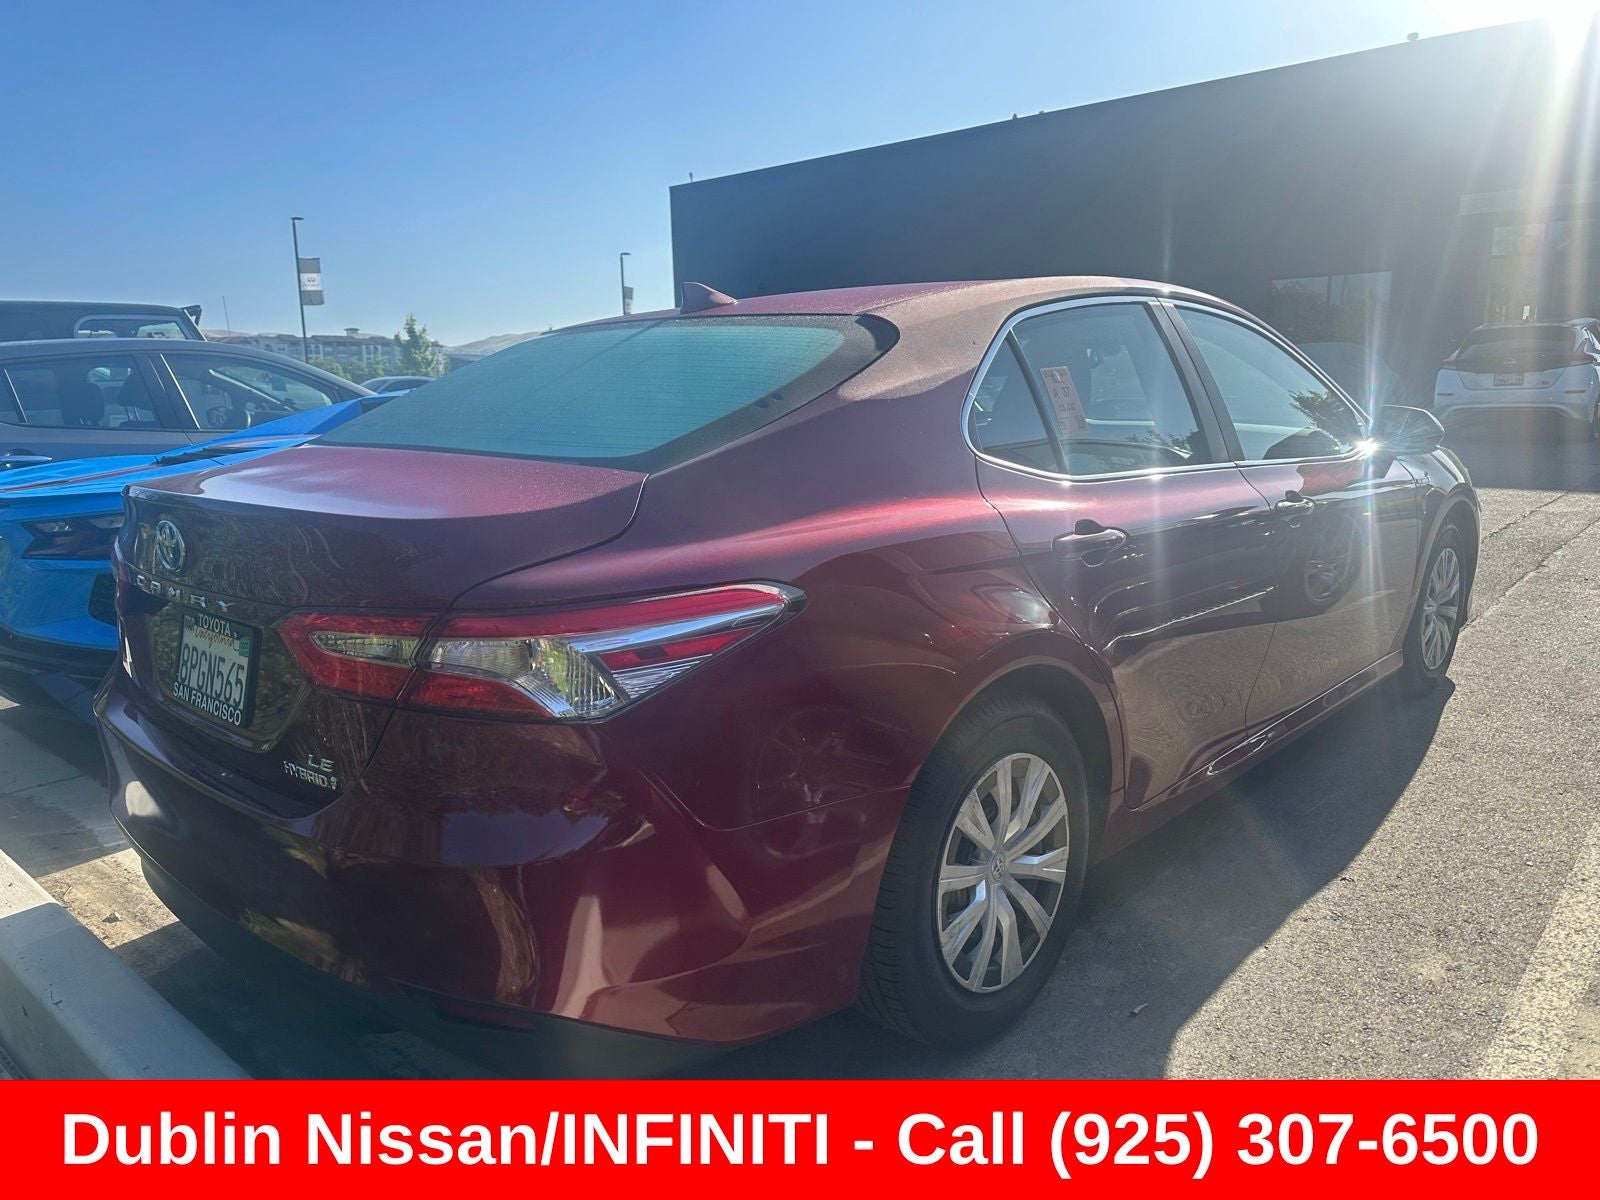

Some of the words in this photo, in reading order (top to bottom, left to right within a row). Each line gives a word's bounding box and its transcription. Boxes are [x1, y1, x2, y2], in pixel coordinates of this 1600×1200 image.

[136, 574, 236, 613] CAMRY
[198, 613, 232, 637] TOYOTA
[180, 643, 245, 708] 8PGN565
[173, 681, 190, 702] SAN
[190, 690, 242, 726] FRANCISCO
[283, 760, 328, 787] HYBRID
[308, 754, 335, 772] LE
